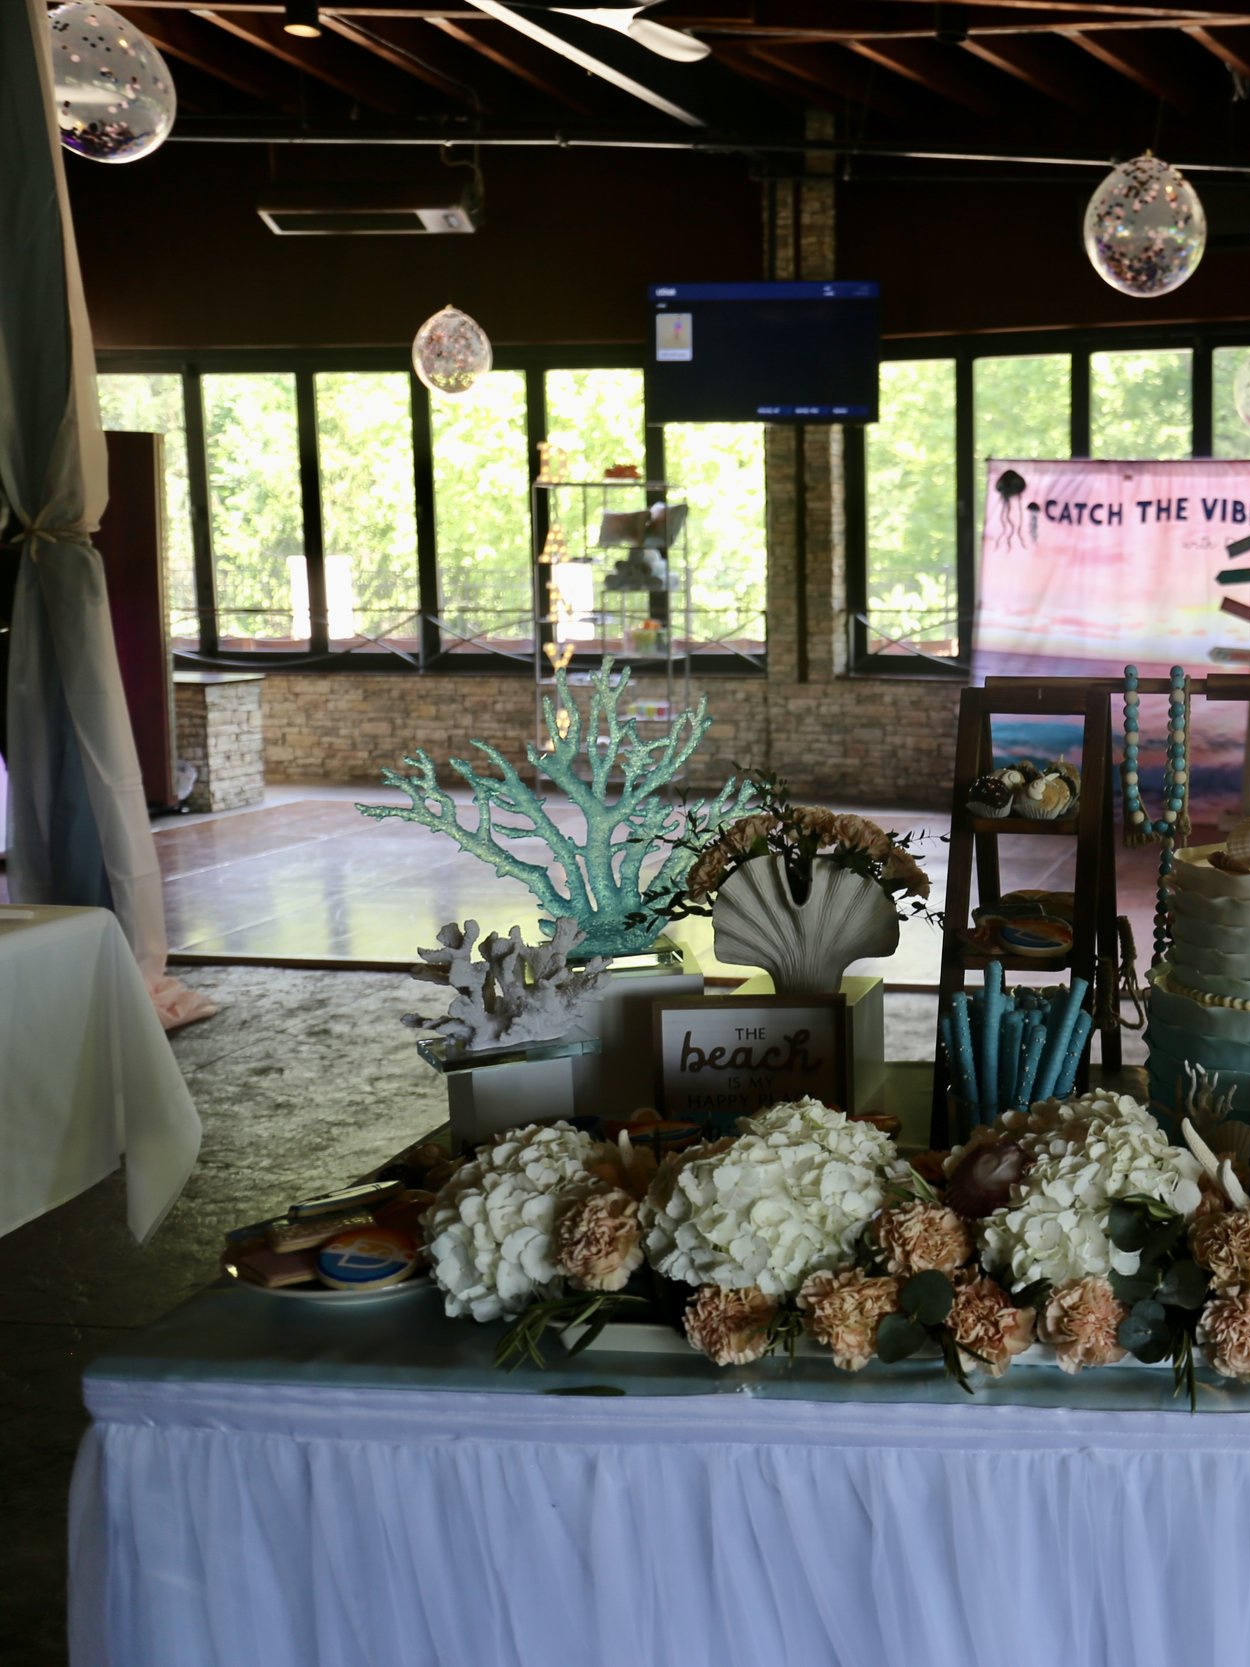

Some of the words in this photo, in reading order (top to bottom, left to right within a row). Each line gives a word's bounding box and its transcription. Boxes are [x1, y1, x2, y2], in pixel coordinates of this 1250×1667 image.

[1044, 499, 1123, 526] CATCH
[1136, 497, 1188, 524] THE
[734, 1027, 767, 1041] THE
[680, 1028, 823, 1073] beach
[728, 1076, 741, 1089] IS
[749, 1075, 774, 1089] MY
[688, 1094, 751, 1109] HAPPY
